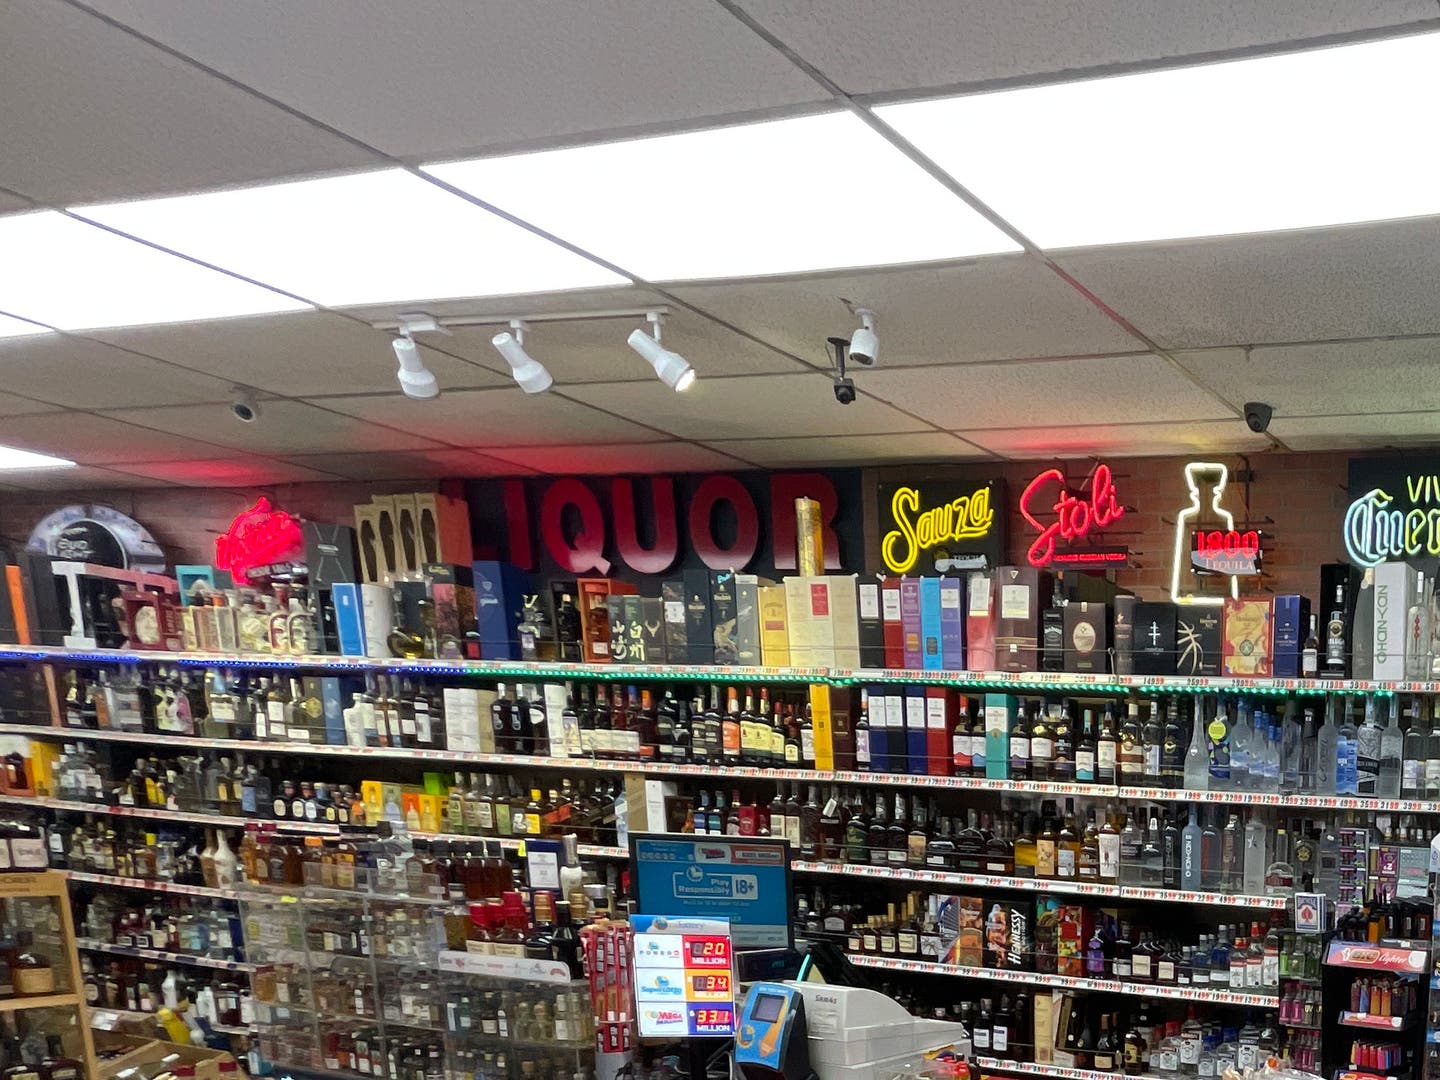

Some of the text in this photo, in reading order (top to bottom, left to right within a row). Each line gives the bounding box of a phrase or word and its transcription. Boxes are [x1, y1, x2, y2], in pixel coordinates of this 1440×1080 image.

[1019, 464, 1124, 566] Stoli
[881, 487, 994, 573] Sauza
[1197, 530, 1259, 558] 1800
[1204, 558, 1255, 570] TEQUILA
[735, 879, 754, 895] 18+
[1007, 908, 1027, 966] HENNESSY
[703, 942, 725, 955] 20
[691, 957, 727, 965] MILLION
[706, 977, 727, 990] 34
[696, 1024, 730, 1033] MILLION
